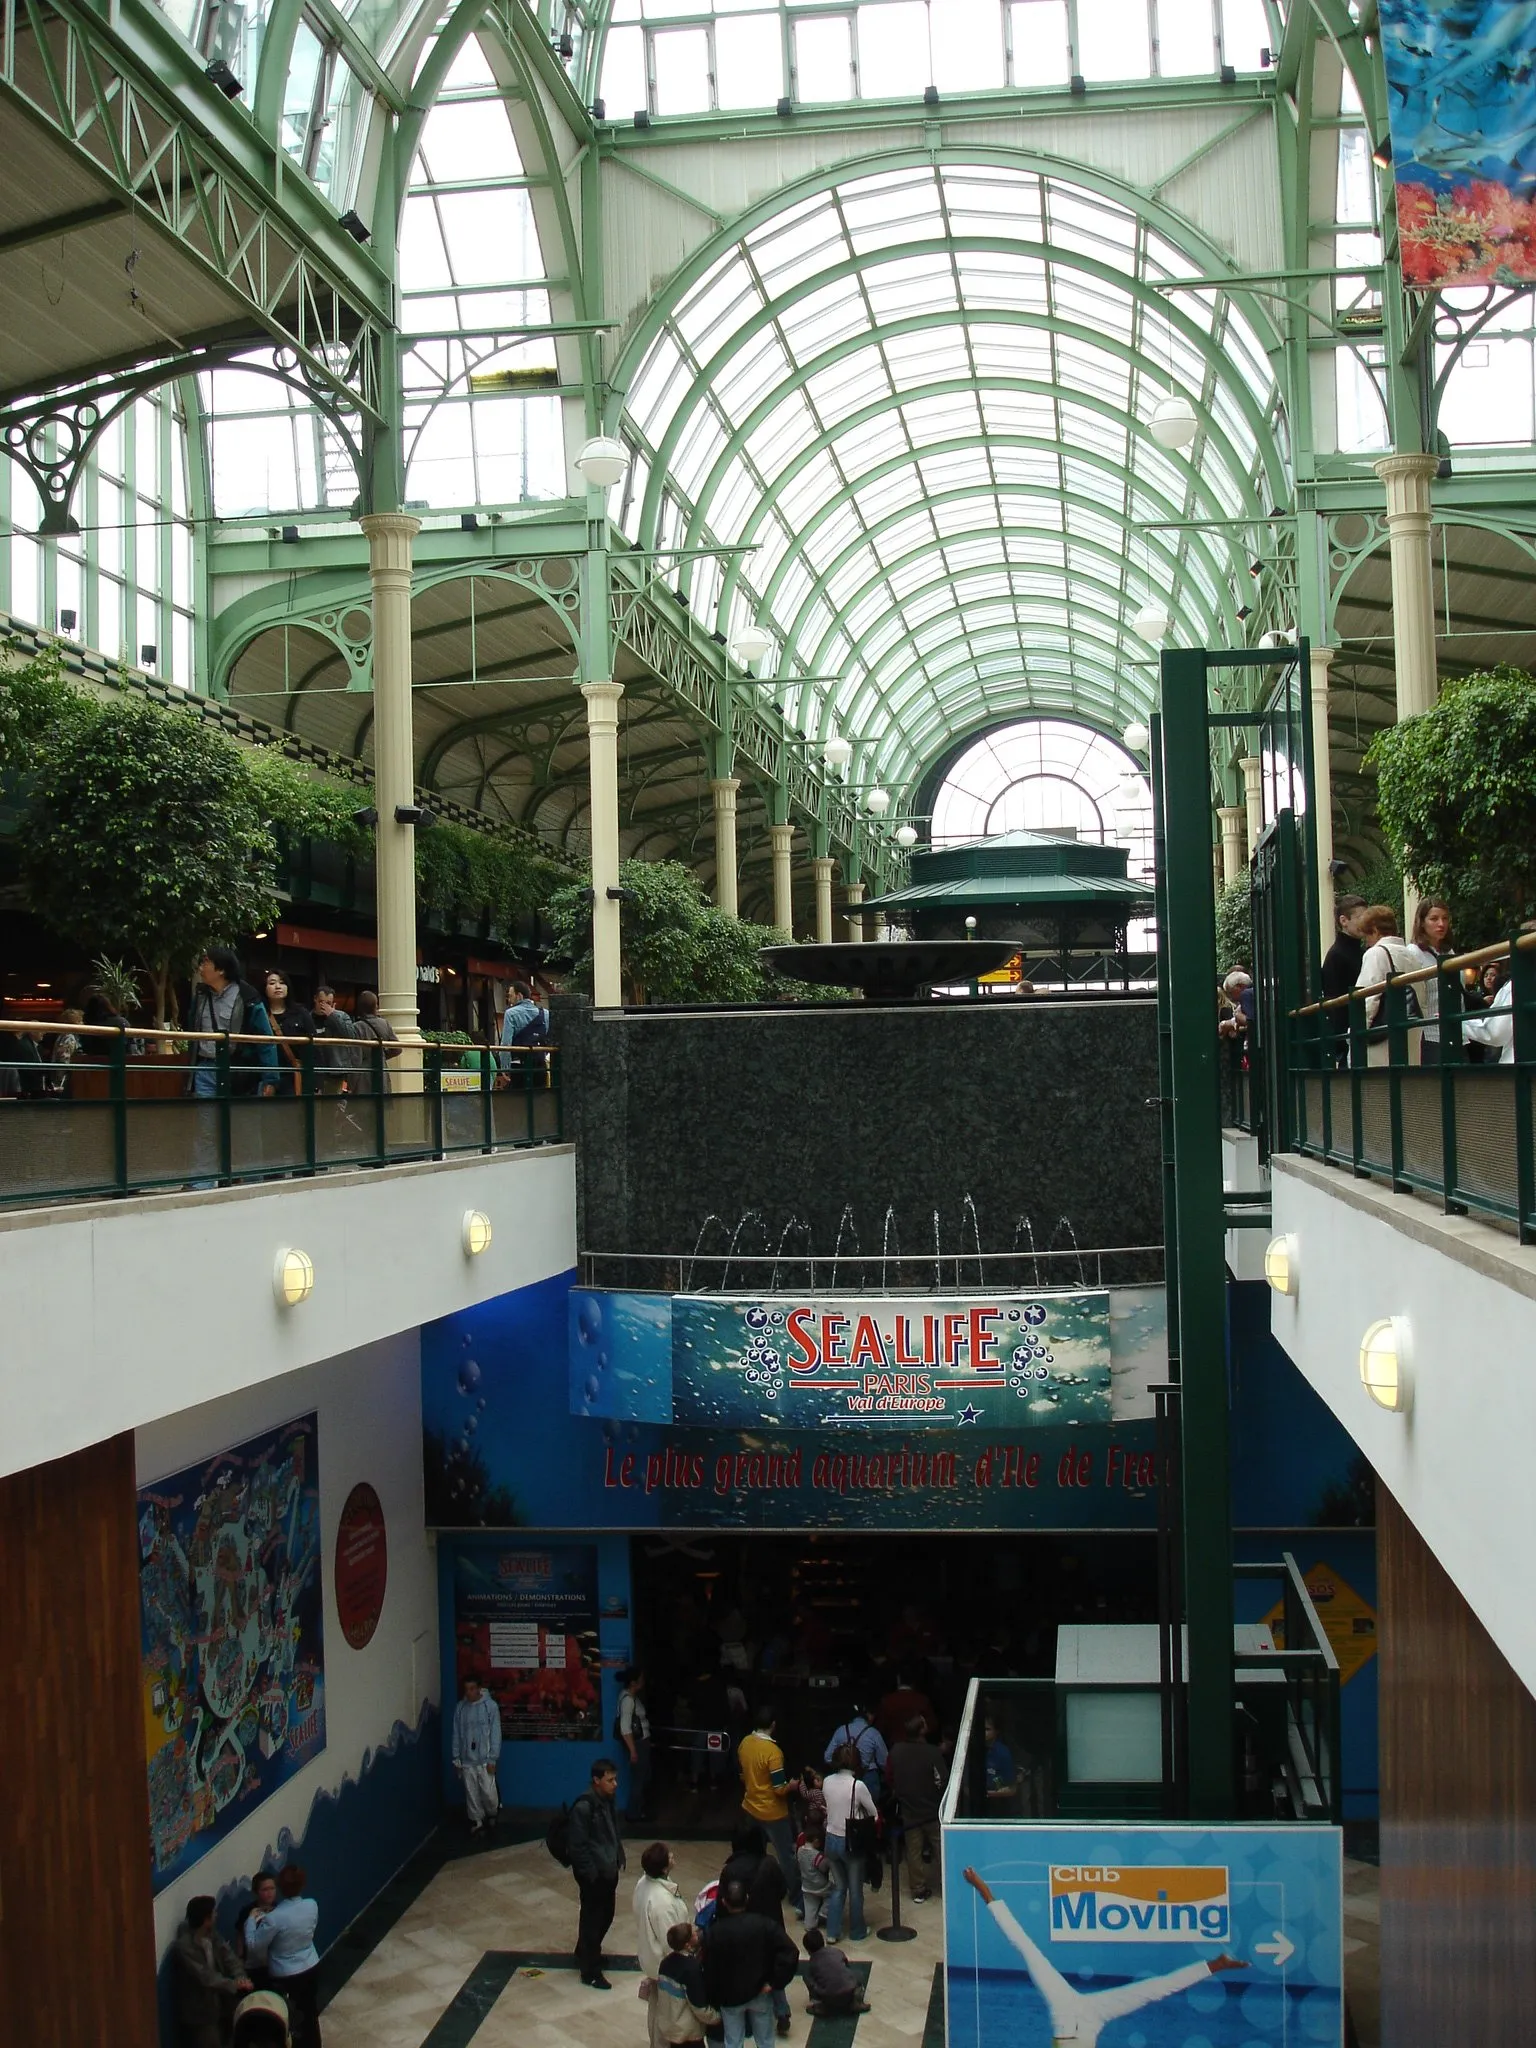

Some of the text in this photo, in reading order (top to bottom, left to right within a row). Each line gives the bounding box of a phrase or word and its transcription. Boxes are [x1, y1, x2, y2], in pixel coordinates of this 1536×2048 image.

[864, 1374, 931, 1395] PARIS
[848, 1395, 945, 1411] Val d'Europe
[605, 1447, 635, 1488] Le
[645, 1446, 703, 1494] plus
[714, 1446, 802, 1495] grand
[812, 1443, 956, 1495] aquarium
[1057, 1445, 1092, 1488] de
[467, 1593, 513, 1601] ANIMATIONS
[1054, 1867, 1120, 1882] Club
[1052, 1890, 1228, 1939] Moving
